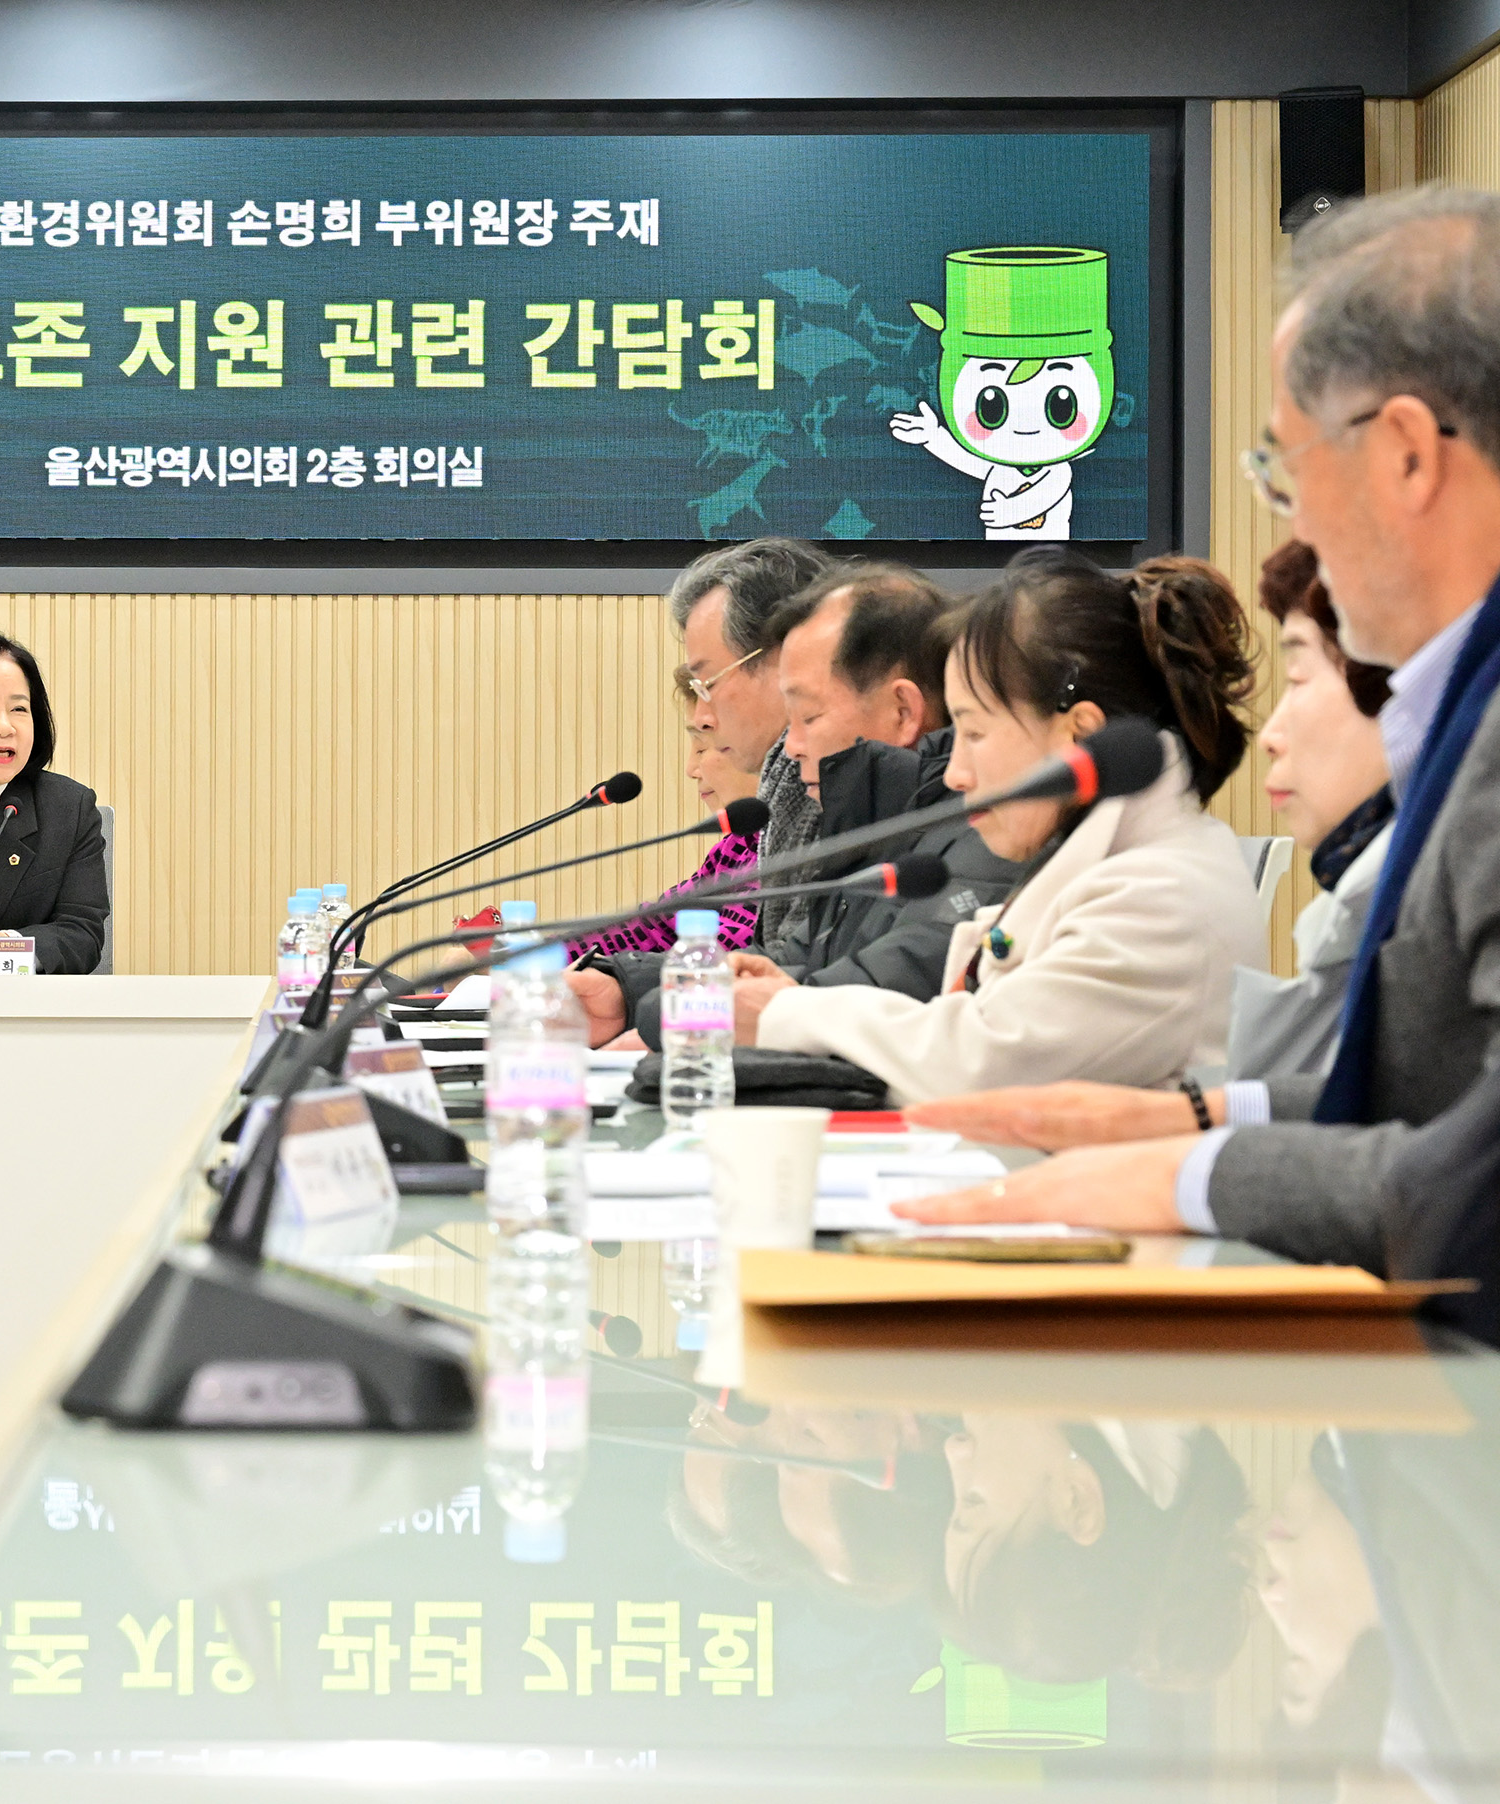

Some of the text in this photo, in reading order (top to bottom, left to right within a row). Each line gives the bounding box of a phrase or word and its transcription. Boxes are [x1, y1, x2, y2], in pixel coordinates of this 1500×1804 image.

[227, 199, 362, 248] 손명희
[375, 198, 560, 248] 부위원장
[569, 198, 661, 247] 주재
[117, 298, 286, 391] 지원
[318, 298, 487, 390] 관련
[521, 298, 776, 391] 간담회
[44, 445, 484, 488] 울산광역시의회 2층 회의실
